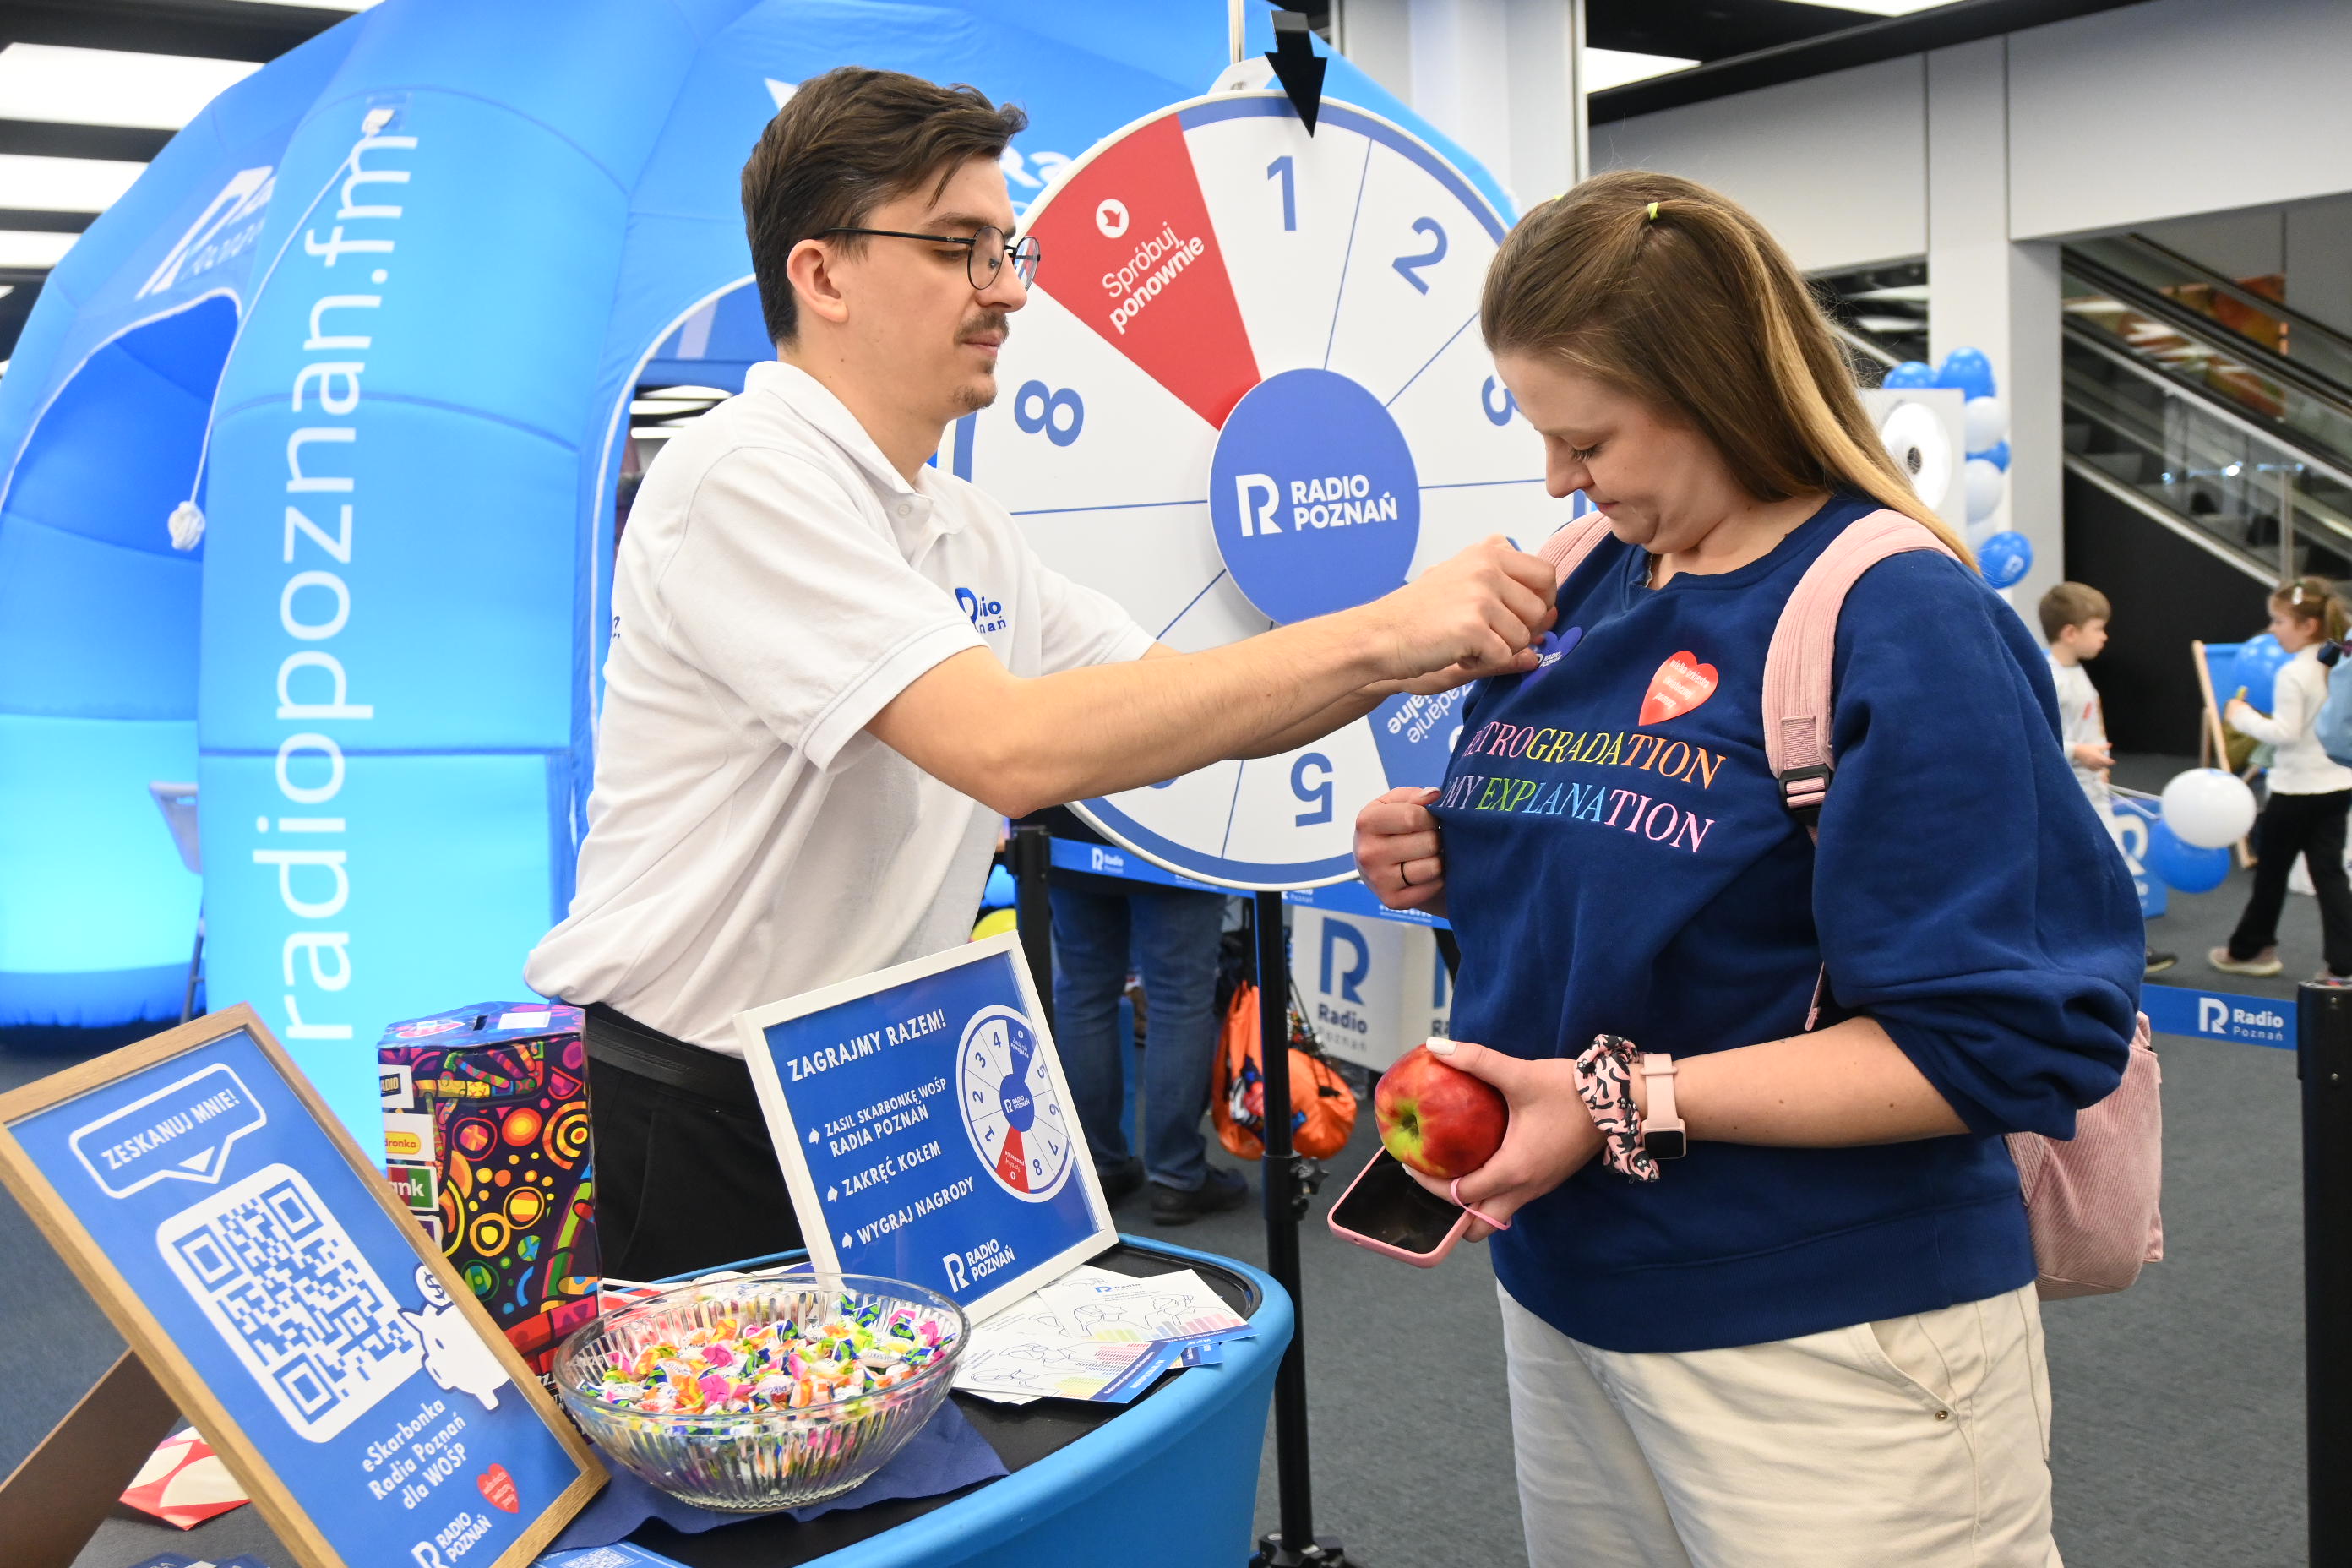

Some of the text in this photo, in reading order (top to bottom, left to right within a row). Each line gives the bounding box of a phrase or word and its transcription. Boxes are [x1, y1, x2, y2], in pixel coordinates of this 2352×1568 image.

[1267, 155, 1297, 231] 1
[1102, 220, 1180, 298] Spróbuj
[1391, 216, 1449, 296] 2
[1109, 237, 1205, 335] ponownie
[1015, 379, 1085, 447] 8
[1290, 474, 1369, 504] RADIO
[1293, 491, 1398, 531] POZNAŃ
[253, 135, 418, 1039] radiopoznan.fm
[1290, 752, 1334, 828] 5
[1475, 777, 1717, 853] EXPLANATION
[787, 1008, 947, 1082] ZAGRAJMY RAZEM!
[993, 1031, 1002, 1048] 4
[1318, 1003, 1369, 1036] Radio
[2233, 1008, 2284, 1028] Radio
[2233, 1026, 2284, 1041] Poznań
[975, 1052, 987, 1069] 3
[1037, 1064, 1047, 1079] 5
[824, 1076, 947, 1137] ZASIL SKARBONKĘ WOŚP
[972, 1090, 984, 1103] 2
[1048, 1103, 1060, 1116] 6
[101, 1088, 241, 1170] ZESKANUJ MNIE!
[830, 1099, 929, 1158] RADIA POZNAŃ
[984, 1125, 995, 1143] 1
[841, 1140, 942, 1197] ZAKRĘĆ KOŁEM
[1032, 1158, 1043, 1176] 8
[857, 1176, 974, 1244] WYGRAJ NAGRODY
[965, 1239, 999, 1266] RADIO
[971, 1244, 1015, 1282] POZNAŃ
[362, 1399, 446, 1473] eSkarbonka
[368, 1411, 467, 1500] Radia Poznań
[401, 1441, 467, 1510] dla WOŚP
[434, 1511, 472, 1549] RADIO
[445, 1513, 493, 1563] POZNAŃ
